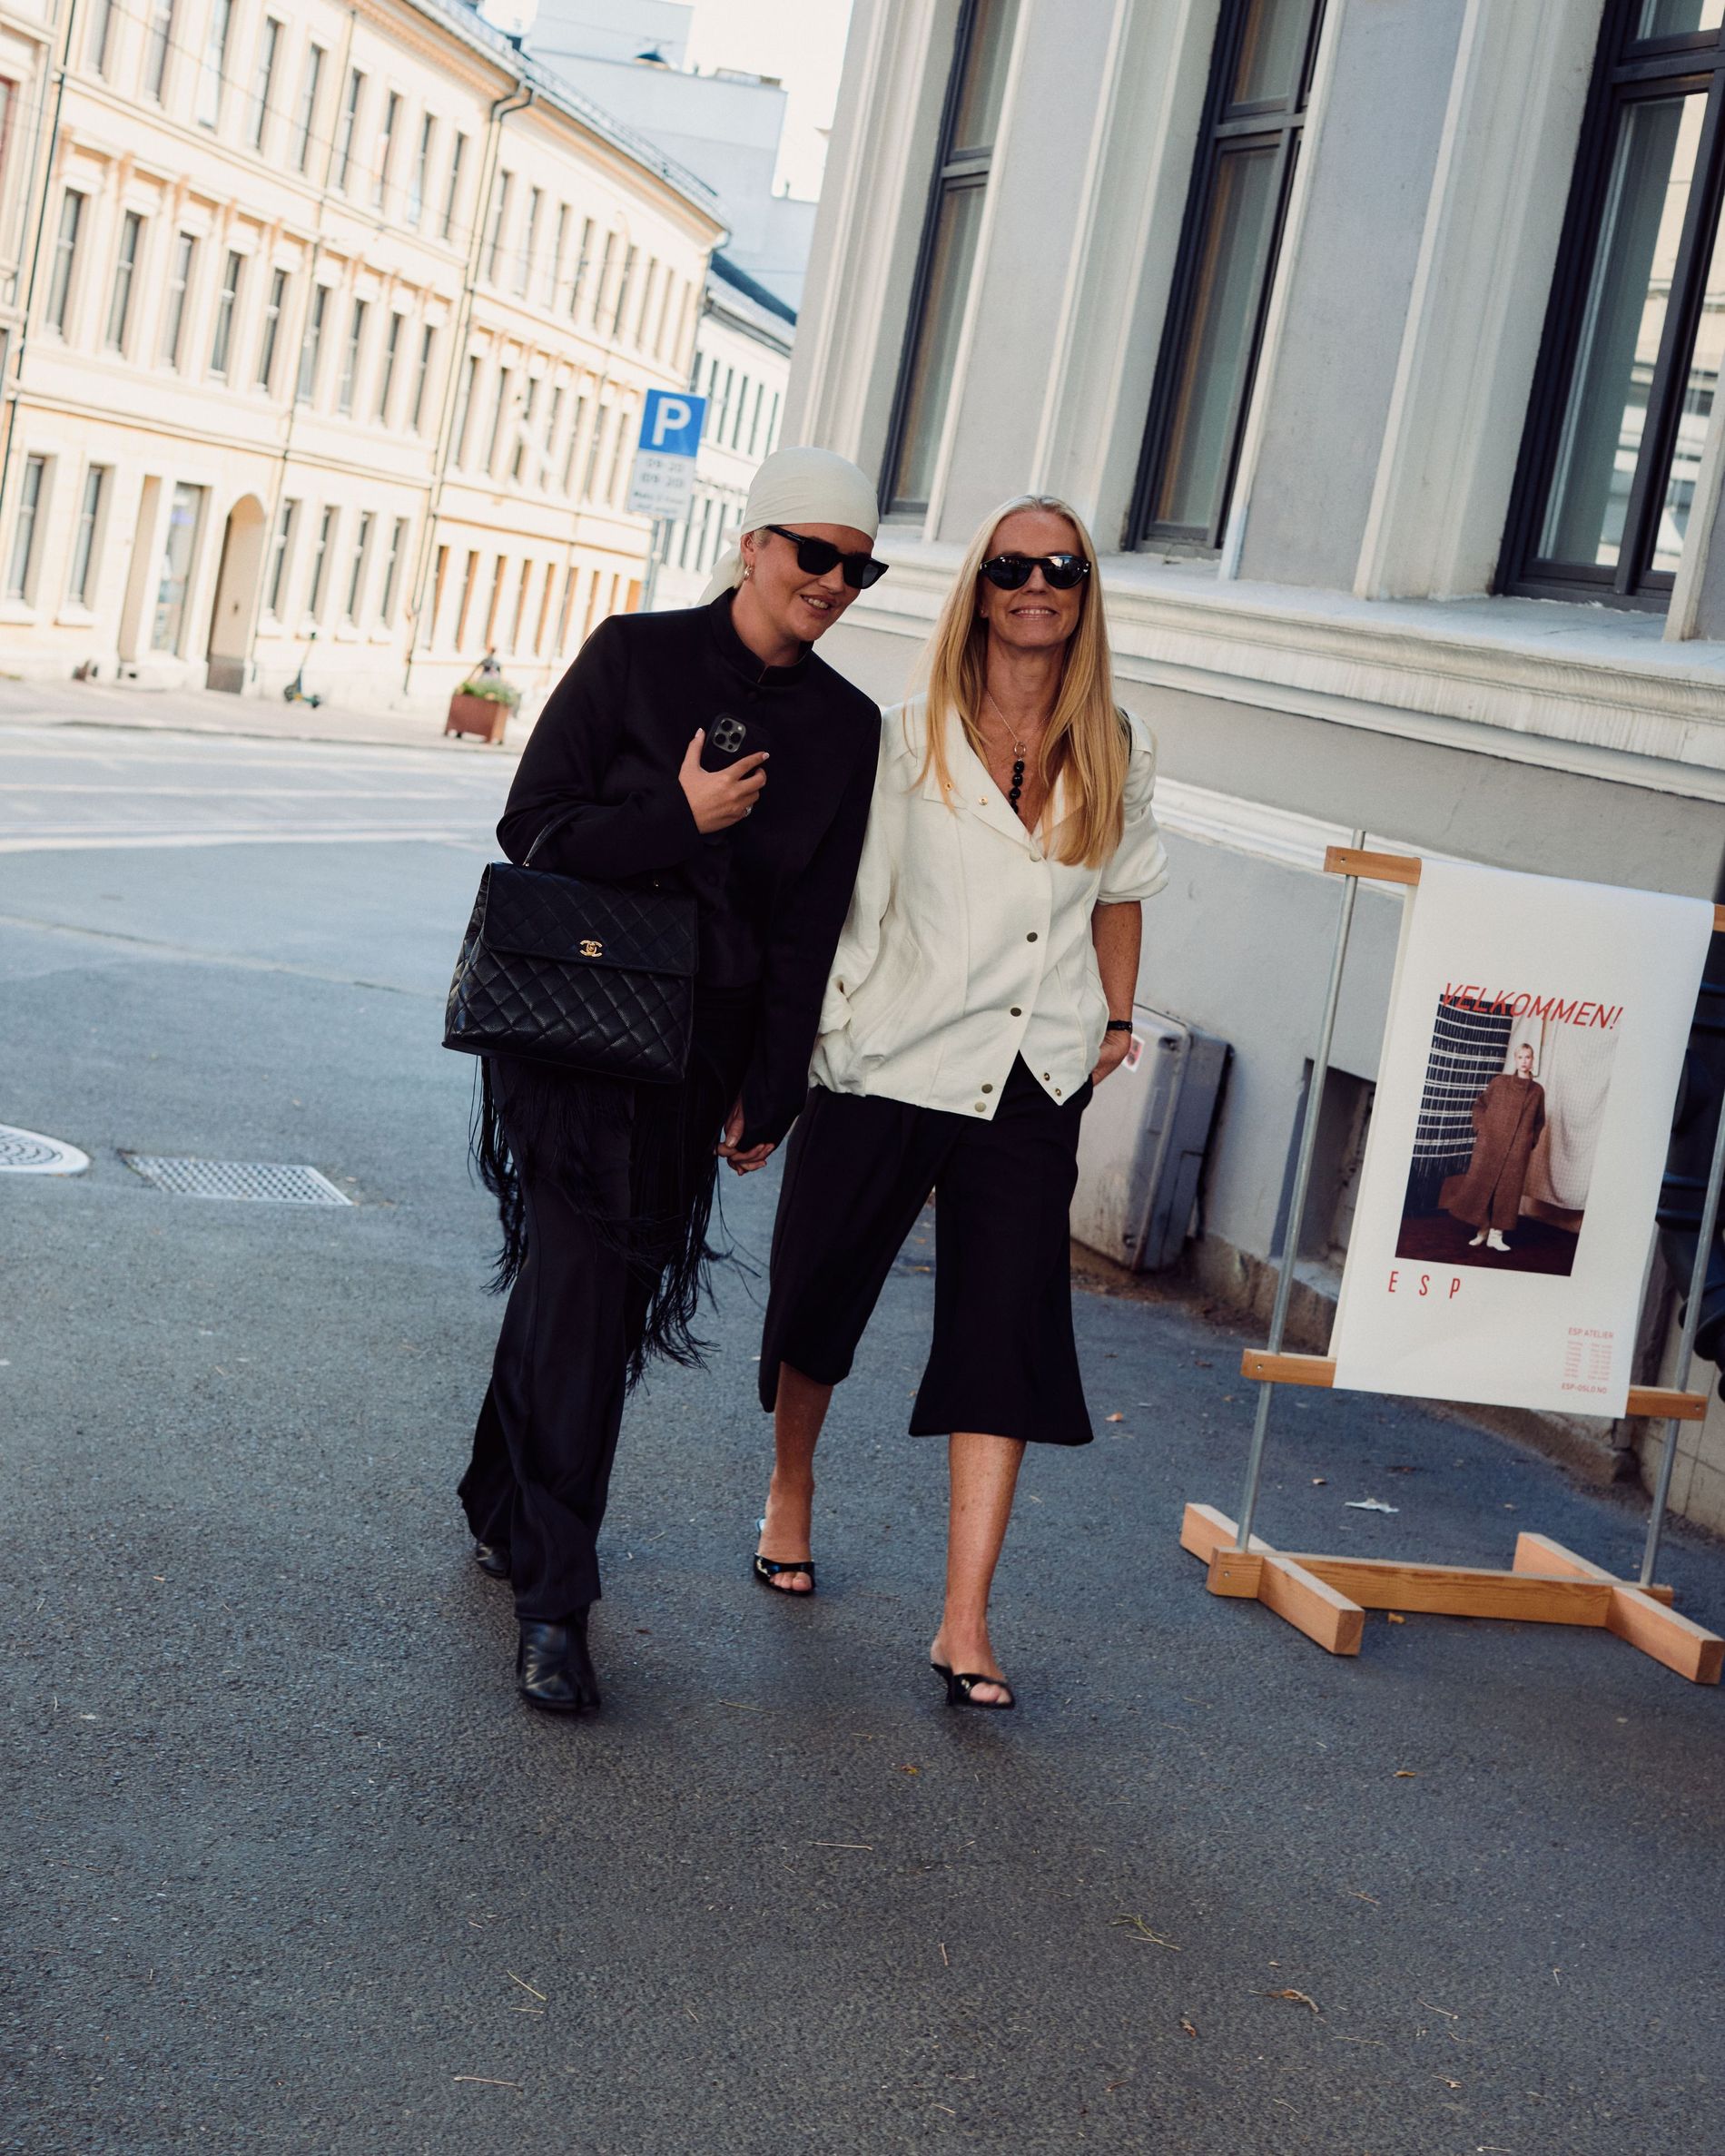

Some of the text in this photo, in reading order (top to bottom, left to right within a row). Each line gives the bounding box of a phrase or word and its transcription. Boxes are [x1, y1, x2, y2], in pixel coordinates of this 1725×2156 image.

[651, 397, 692, 446] P
[1441, 982, 1624, 1030] VELKOMMEN!
[1568, 1327, 1614, 1340] ESP ATELIER
